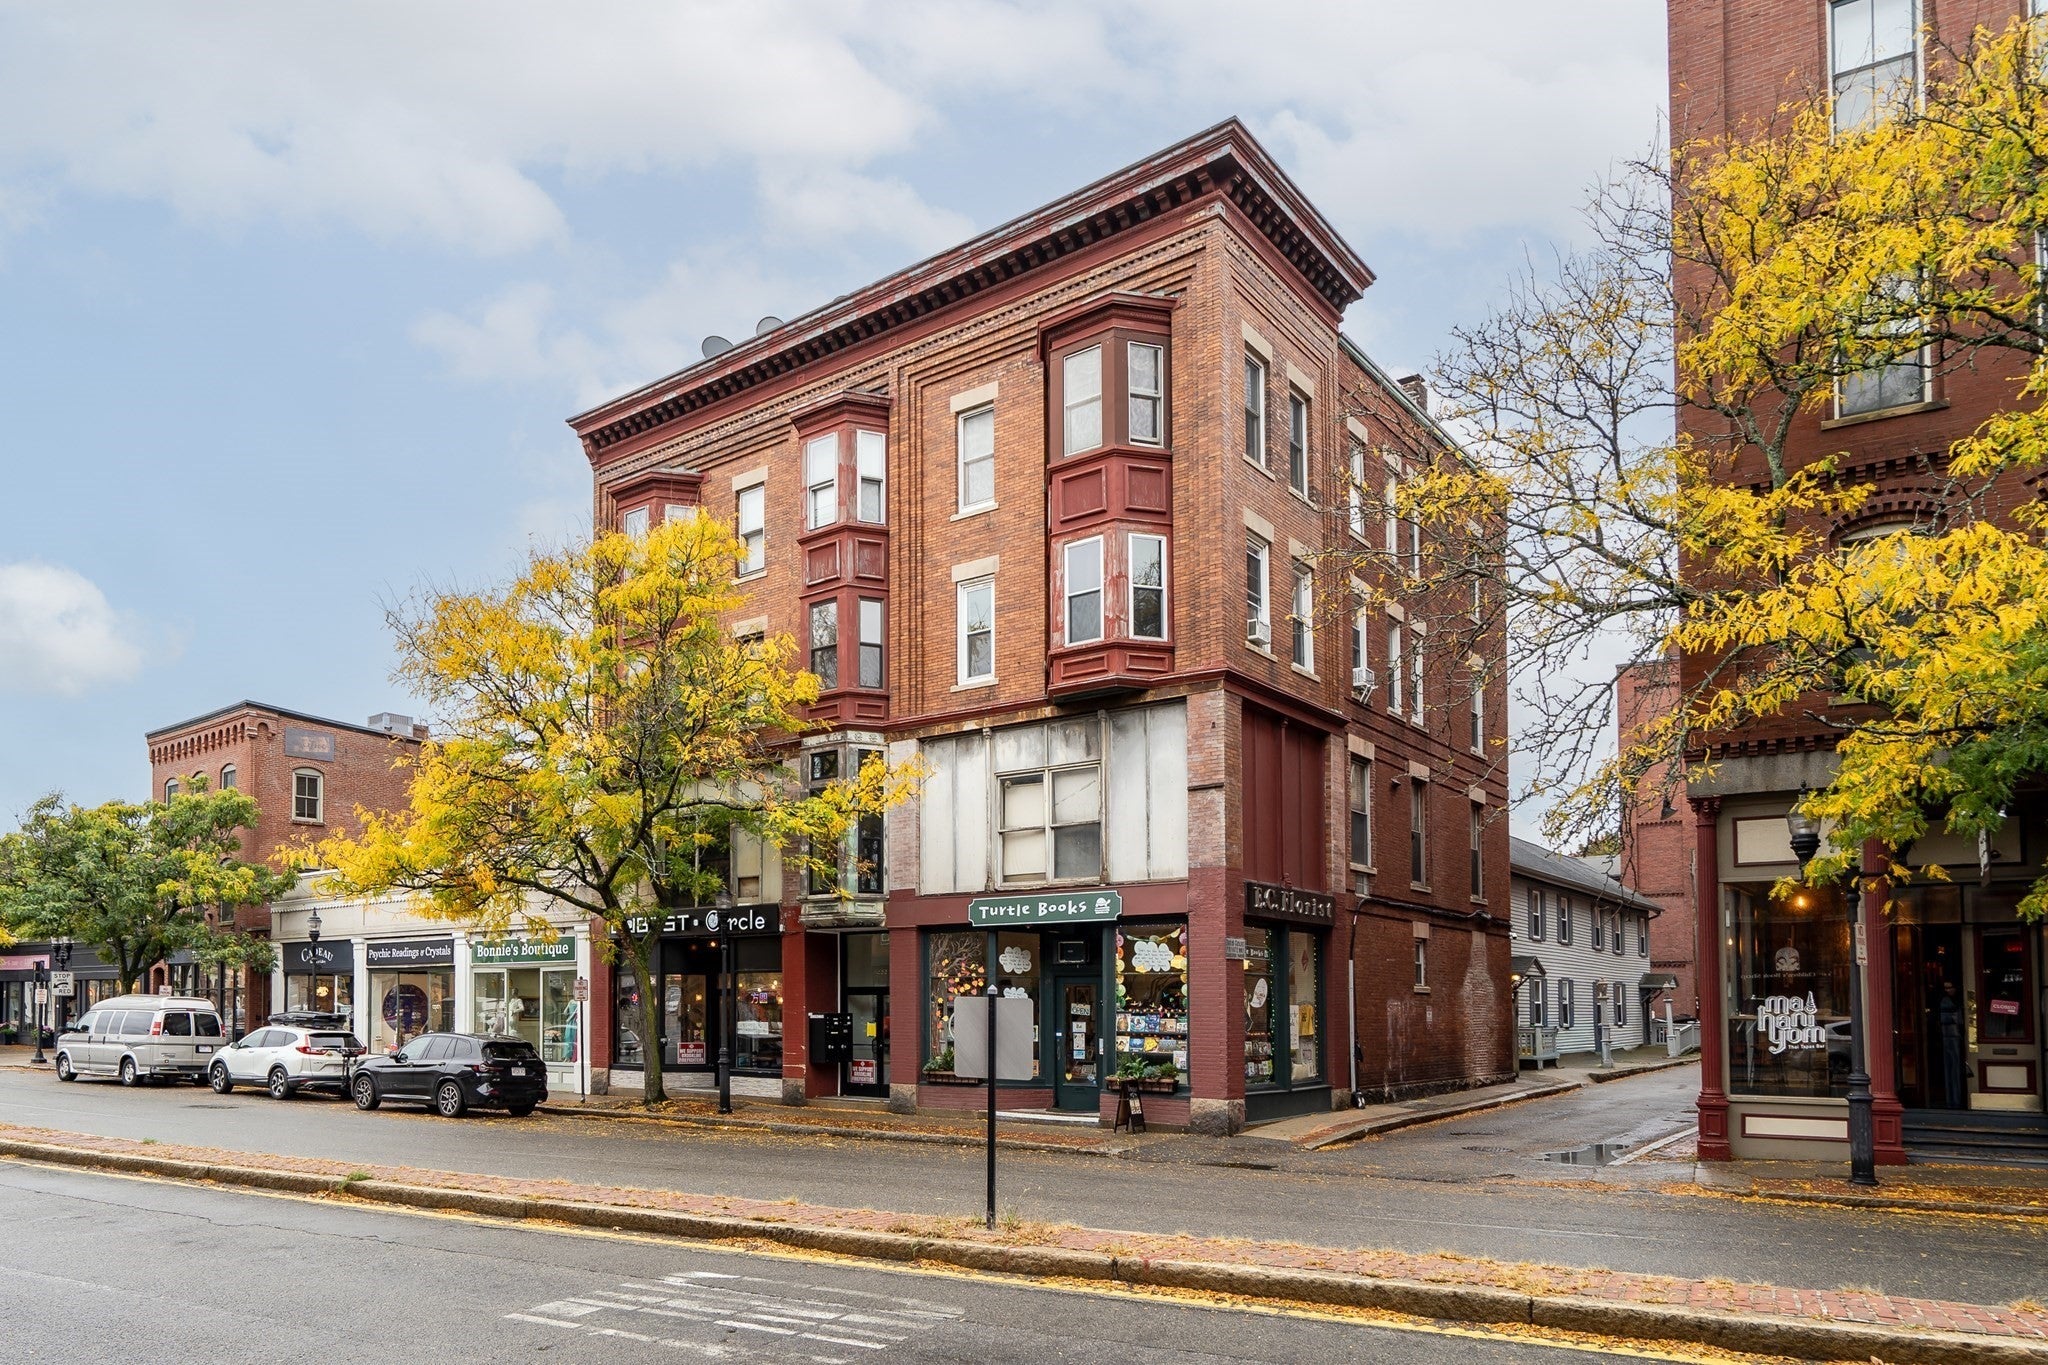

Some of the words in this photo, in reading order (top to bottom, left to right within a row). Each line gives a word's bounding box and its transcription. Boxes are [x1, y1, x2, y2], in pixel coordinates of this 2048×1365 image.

[978, 904, 1030, 919] Turtle
[1038, 900, 1087, 917] Books
[1281, 890, 1332, 918] Florist
[705, 909, 765, 932] Crcle
[368, 948, 391, 960] Psychic
[391, 946, 419, 959] Readings
[425, 945, 451, 958] Crystals
[476, 943, 519, 957] Bonnie's
[520, 943, 569, 957] Boutique
